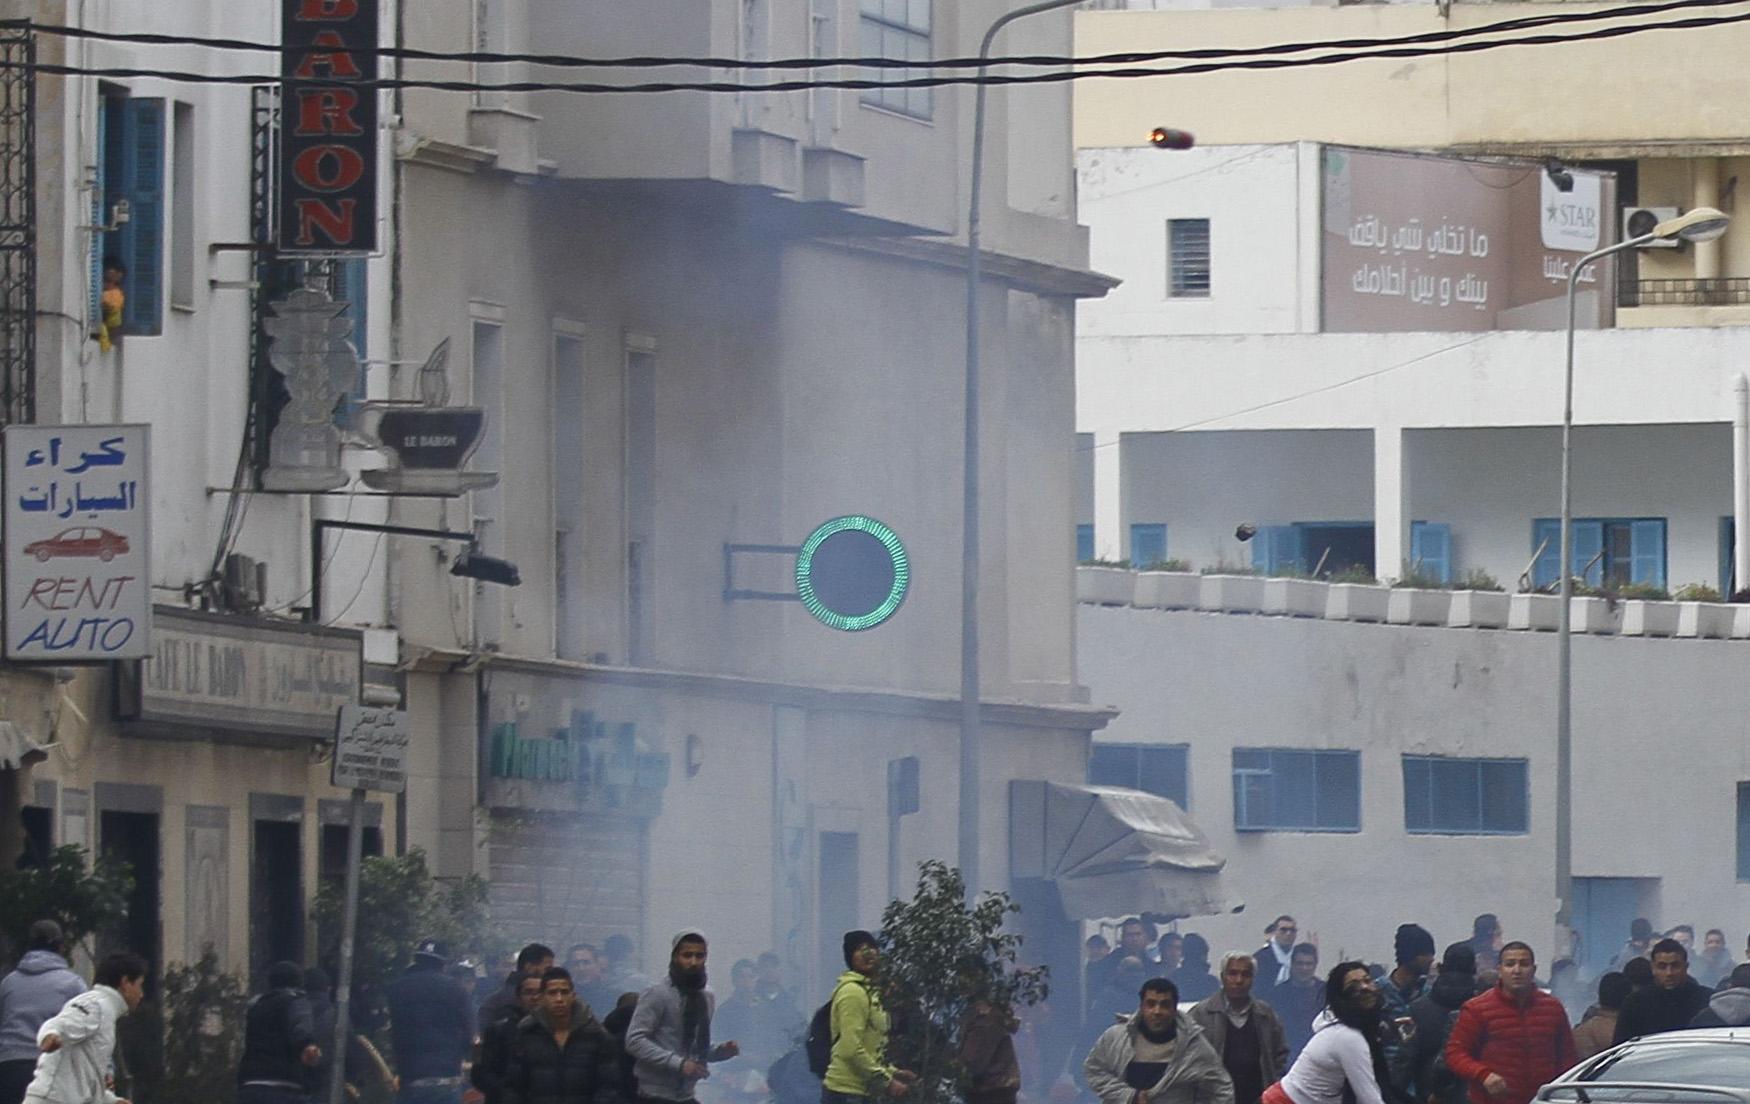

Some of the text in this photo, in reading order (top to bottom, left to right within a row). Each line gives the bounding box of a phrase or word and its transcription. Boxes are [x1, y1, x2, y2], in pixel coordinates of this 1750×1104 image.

[1560, 204, 1596, 228] STAR
[1469, 228, 1488, 257] ما
[1410, 267, 1434, 304] بين
[1440, 277, 1451, 306] و
[1456, 273, 1487, 310] بينك
[25, 437, 126, 474] كراء
[404, 436, 417, 448] LE
[19, 481, 136, 519] السيارات
[20, 576, 136, 610] RENT
[16, 617, 134, 652] AUTO
